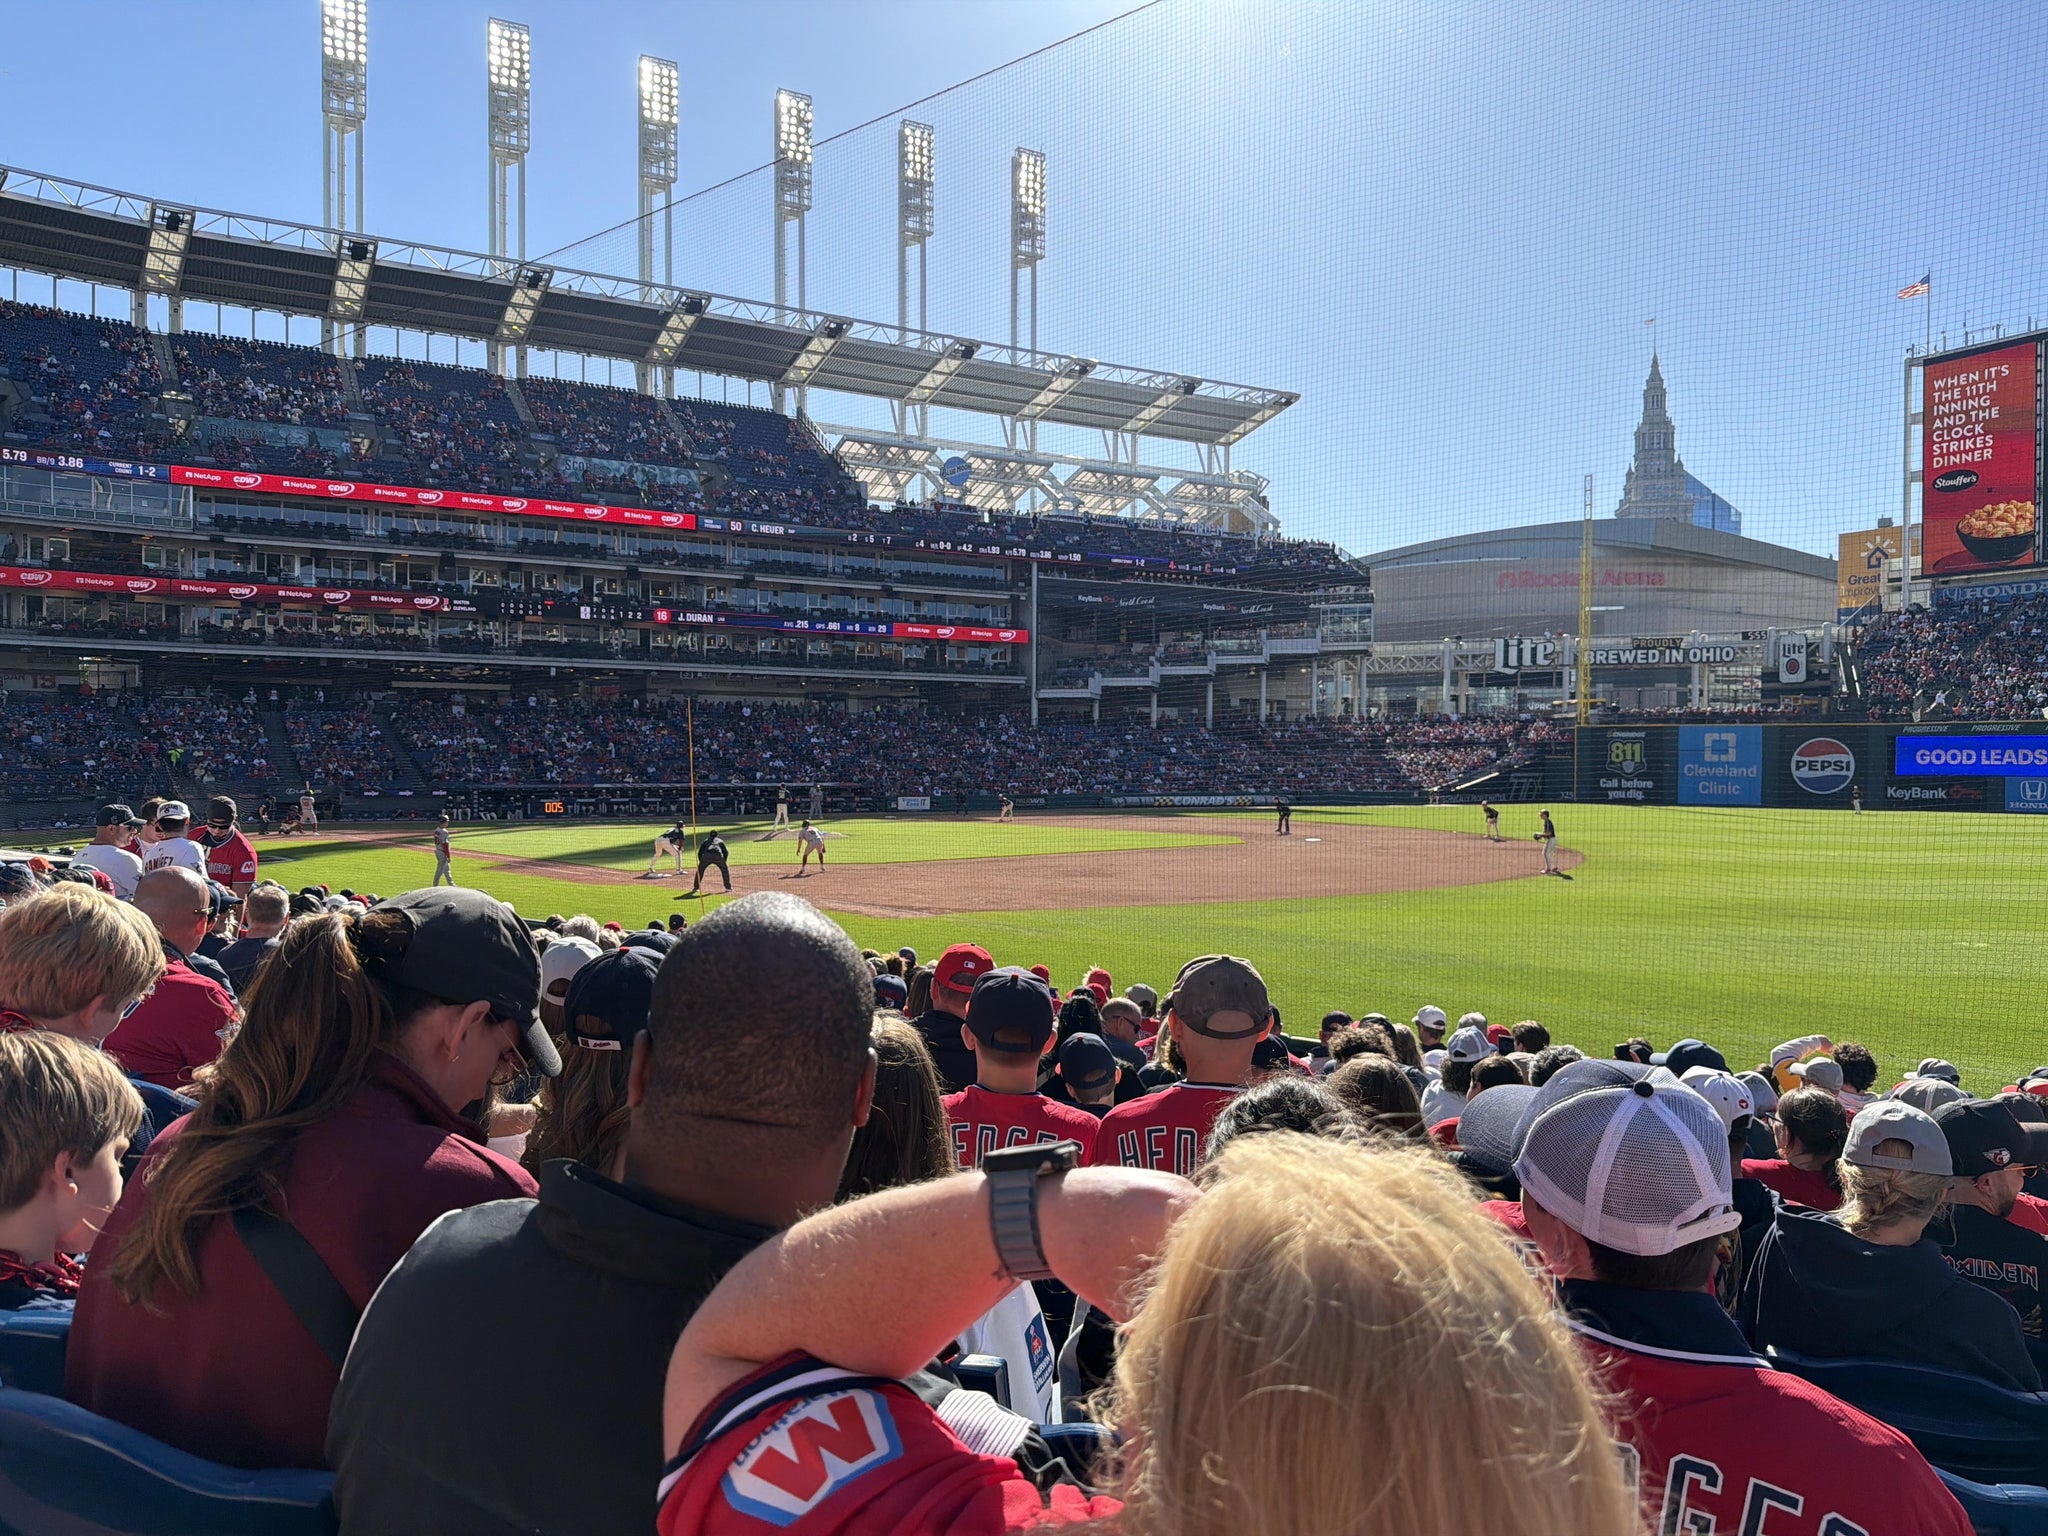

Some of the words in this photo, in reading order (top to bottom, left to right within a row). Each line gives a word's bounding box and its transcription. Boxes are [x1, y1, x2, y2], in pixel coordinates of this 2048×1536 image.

[1934, 371, 1980, 390] WHEN
[1984, 365, 2010, 380] IT'S
[1933, 388, 1962, 404] THE
[1965, 380, 1997, 397] 11TH
[1934, 396, 1990, 416] INNING
[1932, 414, 1966, 430] AND
[1970, 406, 2000, 422] THE
[1932, 422, 1984, 442] CLOCK
[1932, 434, 1994, 456] STRIKES
[2, 448, 28, 462] 5.79
[58, 456, 84, 468] 3.86
[1933, 448, 1992, 468] DINNER
[138, 466, 156, 477] 1-2
[192, 472, 222, 482] NetApp
[233, 474, 260, 487] CDW
[1934, 474, 1977, 488] Stouffer's
[290, 480, 317, 490] NetApp
[328, 484, 354, 495] CDW
[382, 489, 408, 498] NetApp
[418, 492, 442, 502] CDW
[468, 496, 493, 506] NetApp
[503, 500, 526, 510] CDW
[552, 504, 574, 512] NetApp
[584, 506, 606, 518] CDW
[730, 521, 742, 532] 50
[752, 524, 759, 532] C.
[760, 524, 784, 534] HEUER
[920, 540, 924, 548] 4
[940, 541, 952, 550] 0-0
[962, 544, 972, 552] 4.2
[988, 546, 1000, 554] 1.93
[1013, 548, 1026, 557] 5.79
[1040, 550, 1052, 559] 3.86
[1069, 553, 1082, 562] 1.50
[20, 572, 50, 584] CDW
[1602, 569, 1666, 586] Arena
[1848, 574, 1881, 585] Great
[84, 578, 114, 586] NetApp
[127, 579, 155, 592] CDW
[188, 584, 217, 594] NetApp
[229, 586, 256, 598] CDW
[286, 590, 312, 598] NetApp
[324, 591, 349, 602] CDW
[378, 595, 404, 604] NetApp
[414, 596, 438, 607] CDW
[656, 611, 668, 620] 16
[678, 612, 685, 621] J.
[686, 613, 713, 623] DURAN
[795, 620, 808, 629] .215
[826, 622, 840, 630] .661
[855, 623, 860, 631] 8
[1633, 638, 1682, 648] PROUDLY
[1491, 636, 1555, 674] Lite
[1584, 649, 1660, 664] BREWED
[1664, 649, 1684, 663] IN
[1688, 647, 1735, 663] OHIO
[1782, 644, 1804, 657] Lite
[1903, 725, 1949, 733] PROGRESSIVE
[1971, 724, 2021, 732] PROGRESSIVE
[1611, 742, 1642, 763] 811
[1916, 749, 1977, 765] GOOD
[1981, 749, 2048, 765] LEADS
[1684, 764, 1757, 777] Cleveland
[1795, 760, 1850, 772] PEPSI
[1600, 779, 1618, 787] Call
[1621, 778, 1653, 788] before
[1698, 781, 1740, 795] Clinic
[1608, 791, 1625, 800] you
[1626, 790, 1644, 800] dig.
[1887, 786, 1947, 800] KeyBank
[1174, 795, 1234, 806] CONRAD'S
